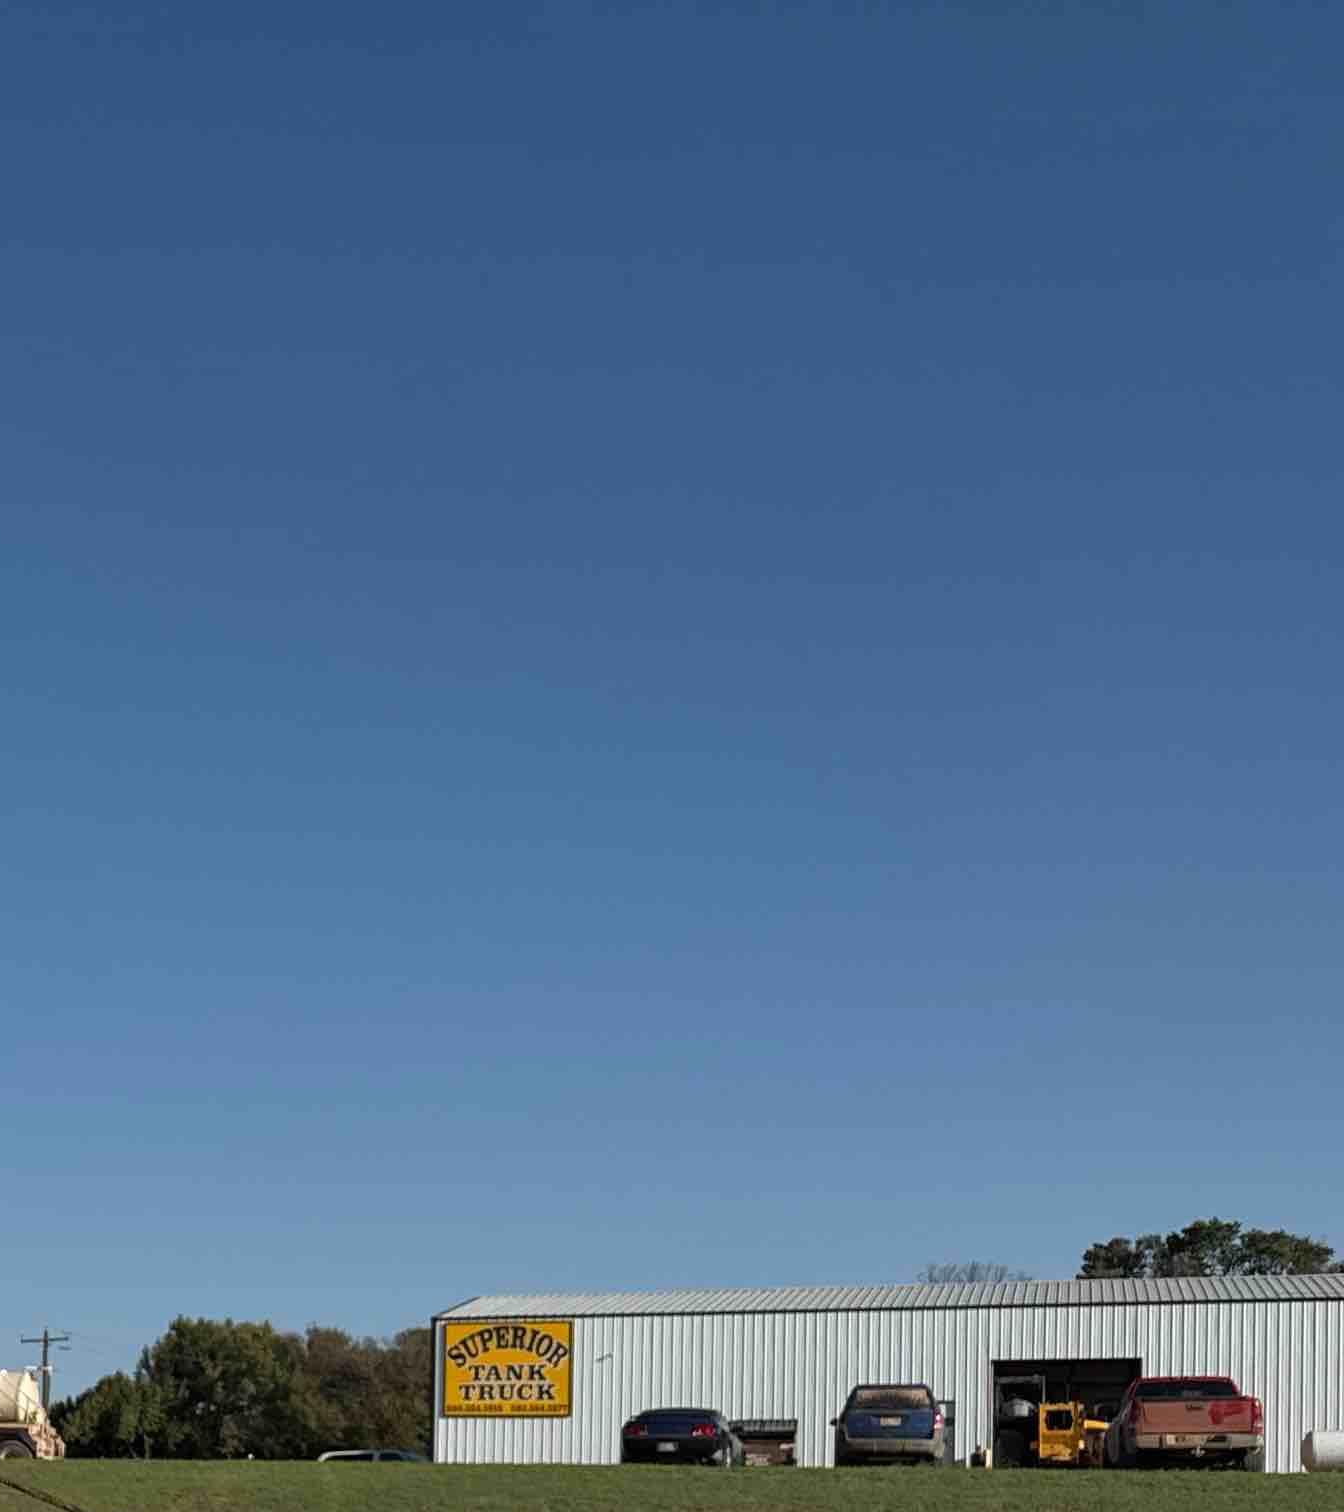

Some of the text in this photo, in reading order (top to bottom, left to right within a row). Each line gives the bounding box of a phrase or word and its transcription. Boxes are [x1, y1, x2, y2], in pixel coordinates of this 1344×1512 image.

[447, 1326, 568, 1368] SUPERIOR
[468, 1364, 547, 1381] TANK
[459, 1384, 555, 1400] TRUCK
